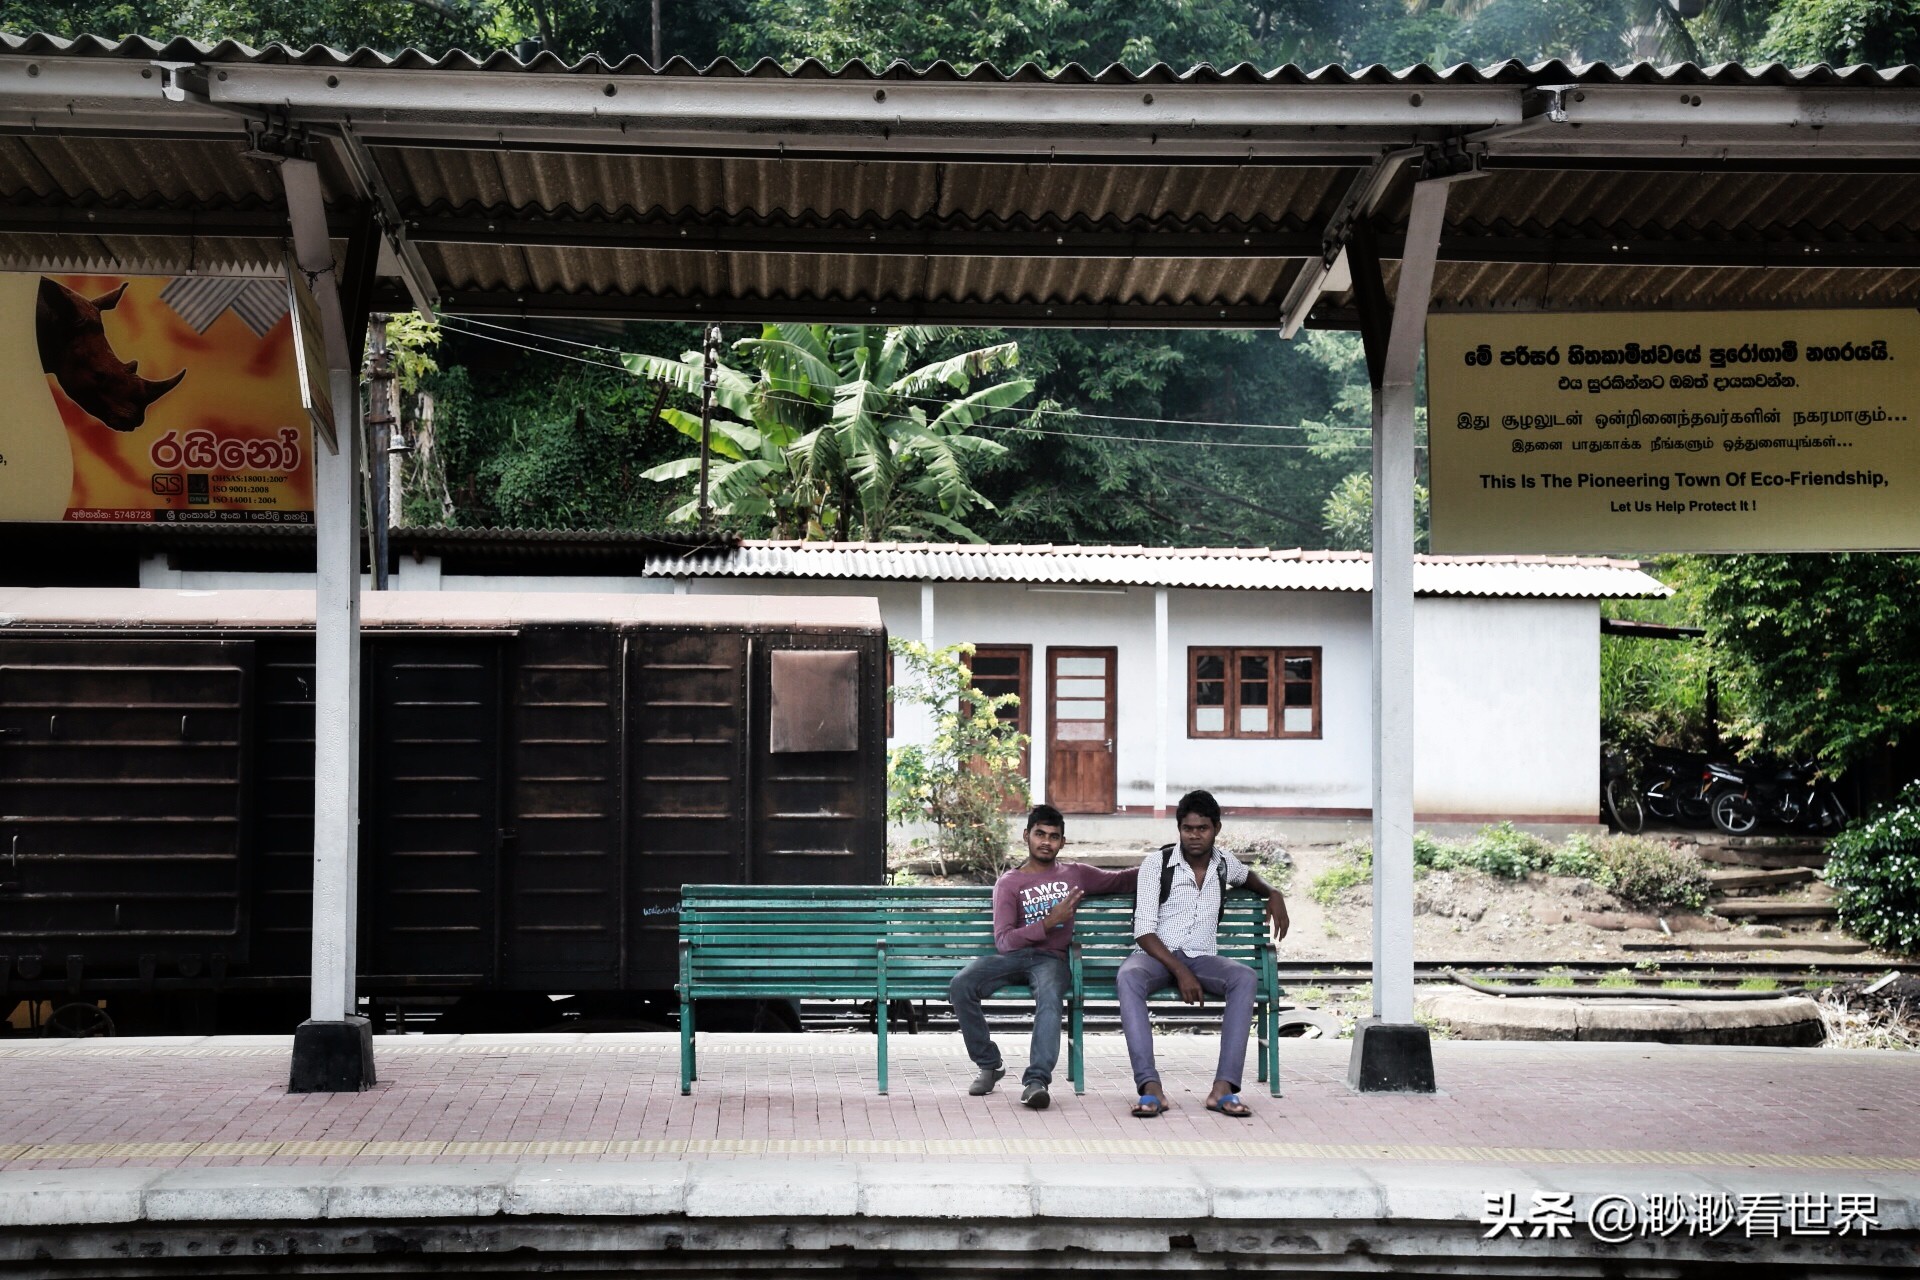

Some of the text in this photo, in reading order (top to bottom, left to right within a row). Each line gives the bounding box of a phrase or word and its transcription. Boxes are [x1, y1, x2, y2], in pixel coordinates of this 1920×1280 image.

[1465, 345, 1492, 366] මේ
[1500, 345, 1560, 366] පරිසර
[1558, 376, 1583, 391] එය
[1588, 374, 1665, 393] සුරකින්නට
[1670, 373, 1709, 390] ඔබත්
[1457, 411, 1490, 430] இது
[1502, 409, 1583, 431] சூழலுடன்
[150, 428, 300, 470] රයිනෝ
[1511, 438, 1563, 454] இதனை
[1572, 437, 1642, 454] பாதுகாக்க
[1651, 436, 1714, 453] நீங்களும்
[212, 485, 269, 493] ISO 9001:2008
[1480, 470, 1889, 491] This Is The Pioneering Town Of Eco-Friendship,
[212, 496, 228, 504] ISO
[230, 496, 252, 504] 14001
[258, 496, 277, 504] 2004
[1611, 500, 1631, 513] Let
[1634, 500, 1652, 513] Us
[1656, 500, 1685, 515] Help
[1689, 500, 1737, 512] Protect
[1740, 499, 1749, 512] It
[114, 510, 151, 519] 5748728
[1019, 881, 1068, 901] TWO
